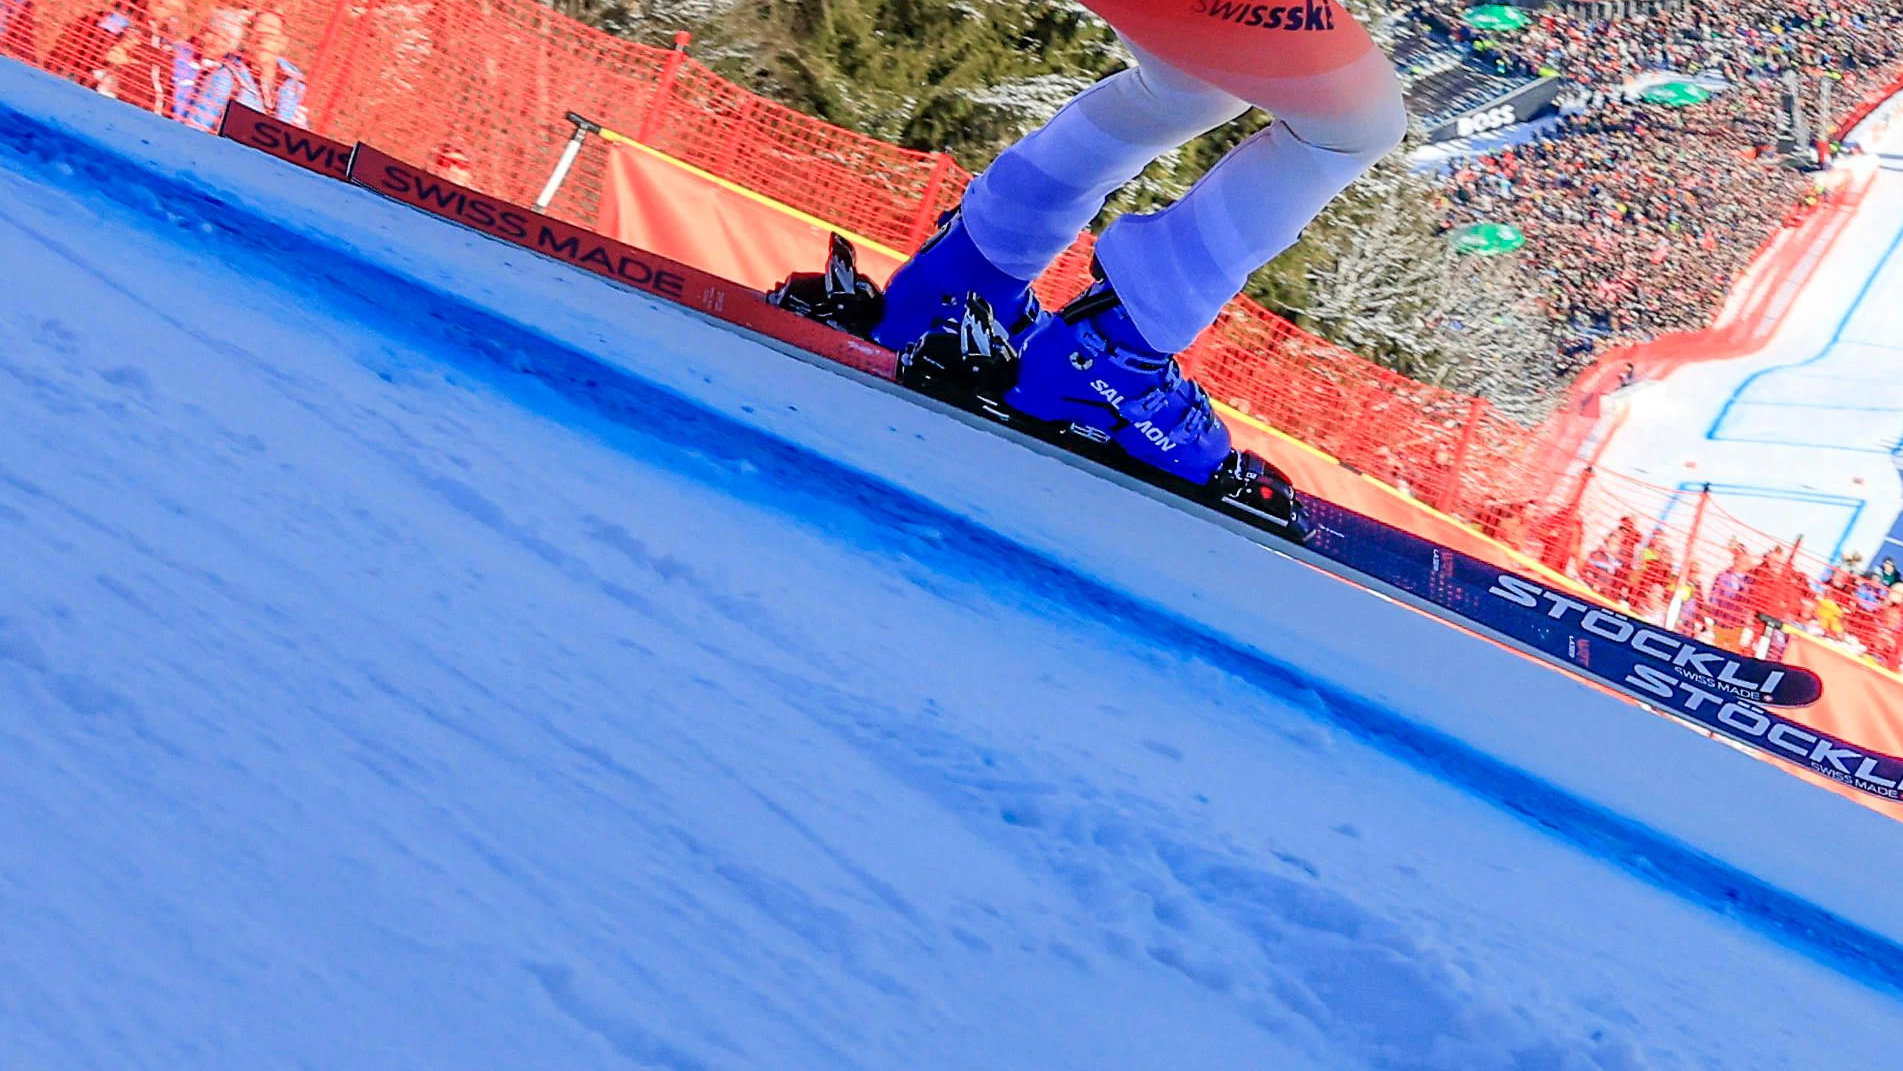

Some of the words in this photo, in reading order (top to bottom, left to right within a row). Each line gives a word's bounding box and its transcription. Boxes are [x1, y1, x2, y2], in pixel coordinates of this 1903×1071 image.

[382, 165, 527, 238] SWISS
[538, 226, 686, 296] MADE
[1489, 574, 1785, 693] STÖCKLI
[1674, 666, 1716, 689] SWISS
[1718, 681, 1761, 701] MADE
[1811, 761, 1853, 785] SWISS
[1855, 778, 1898, 799] MADE
